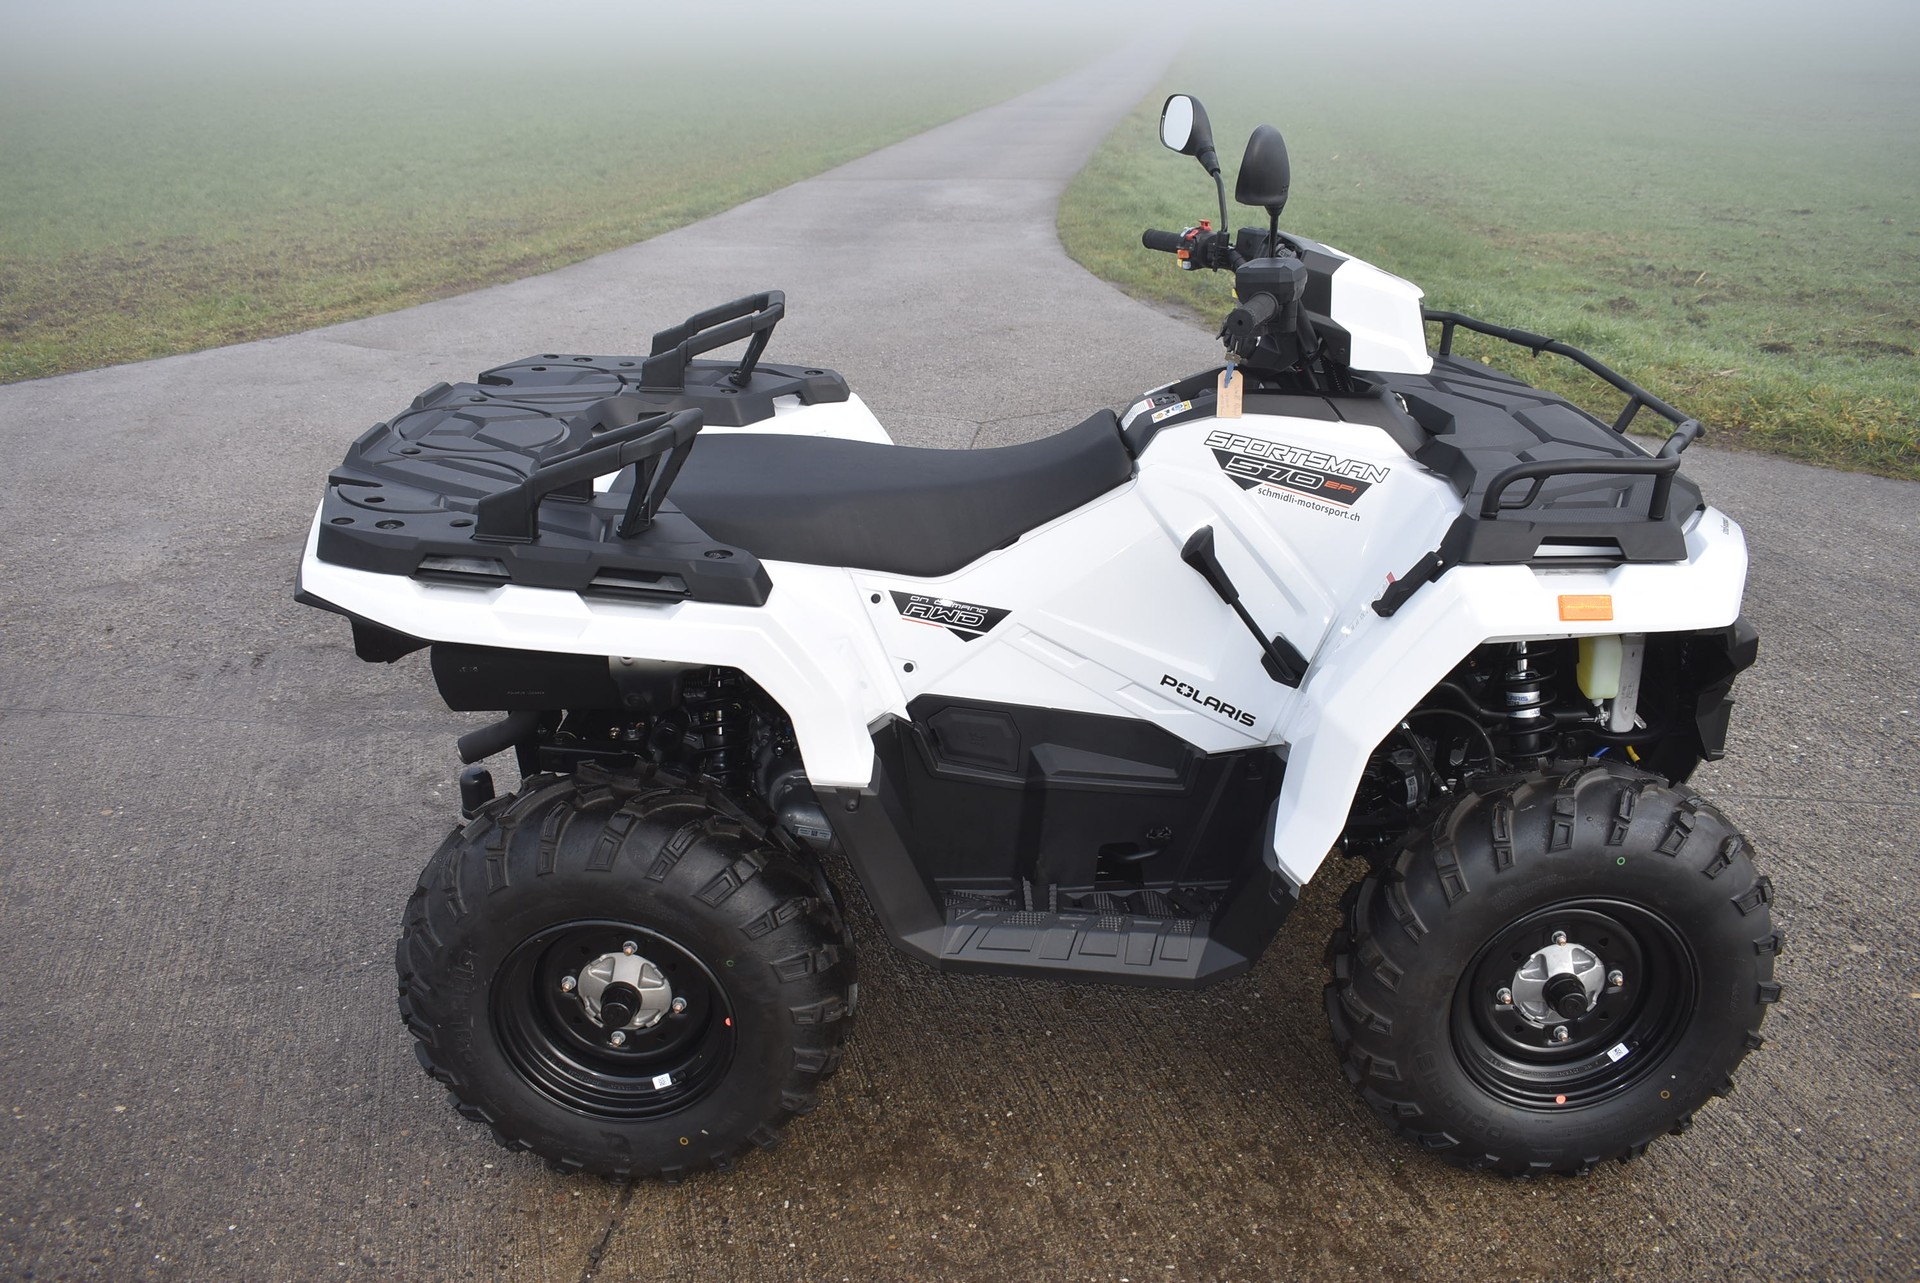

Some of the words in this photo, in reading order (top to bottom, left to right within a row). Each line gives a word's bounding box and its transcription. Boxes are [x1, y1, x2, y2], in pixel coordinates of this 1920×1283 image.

[1204, 430, 1390, 483] SPORTSMAN
[1225, 455, 1324, 489] 570
[1324, 480, 1357, 493] EFI
[1257, 486, 1361, 522] schmidli-motorsport.ch
[903, 602, 984, 627] AWD
[910, 595, 929, 603] ON
[933, 598, 989, 614] DMAND
[1160, 674, 1257, 727] POLARIS
